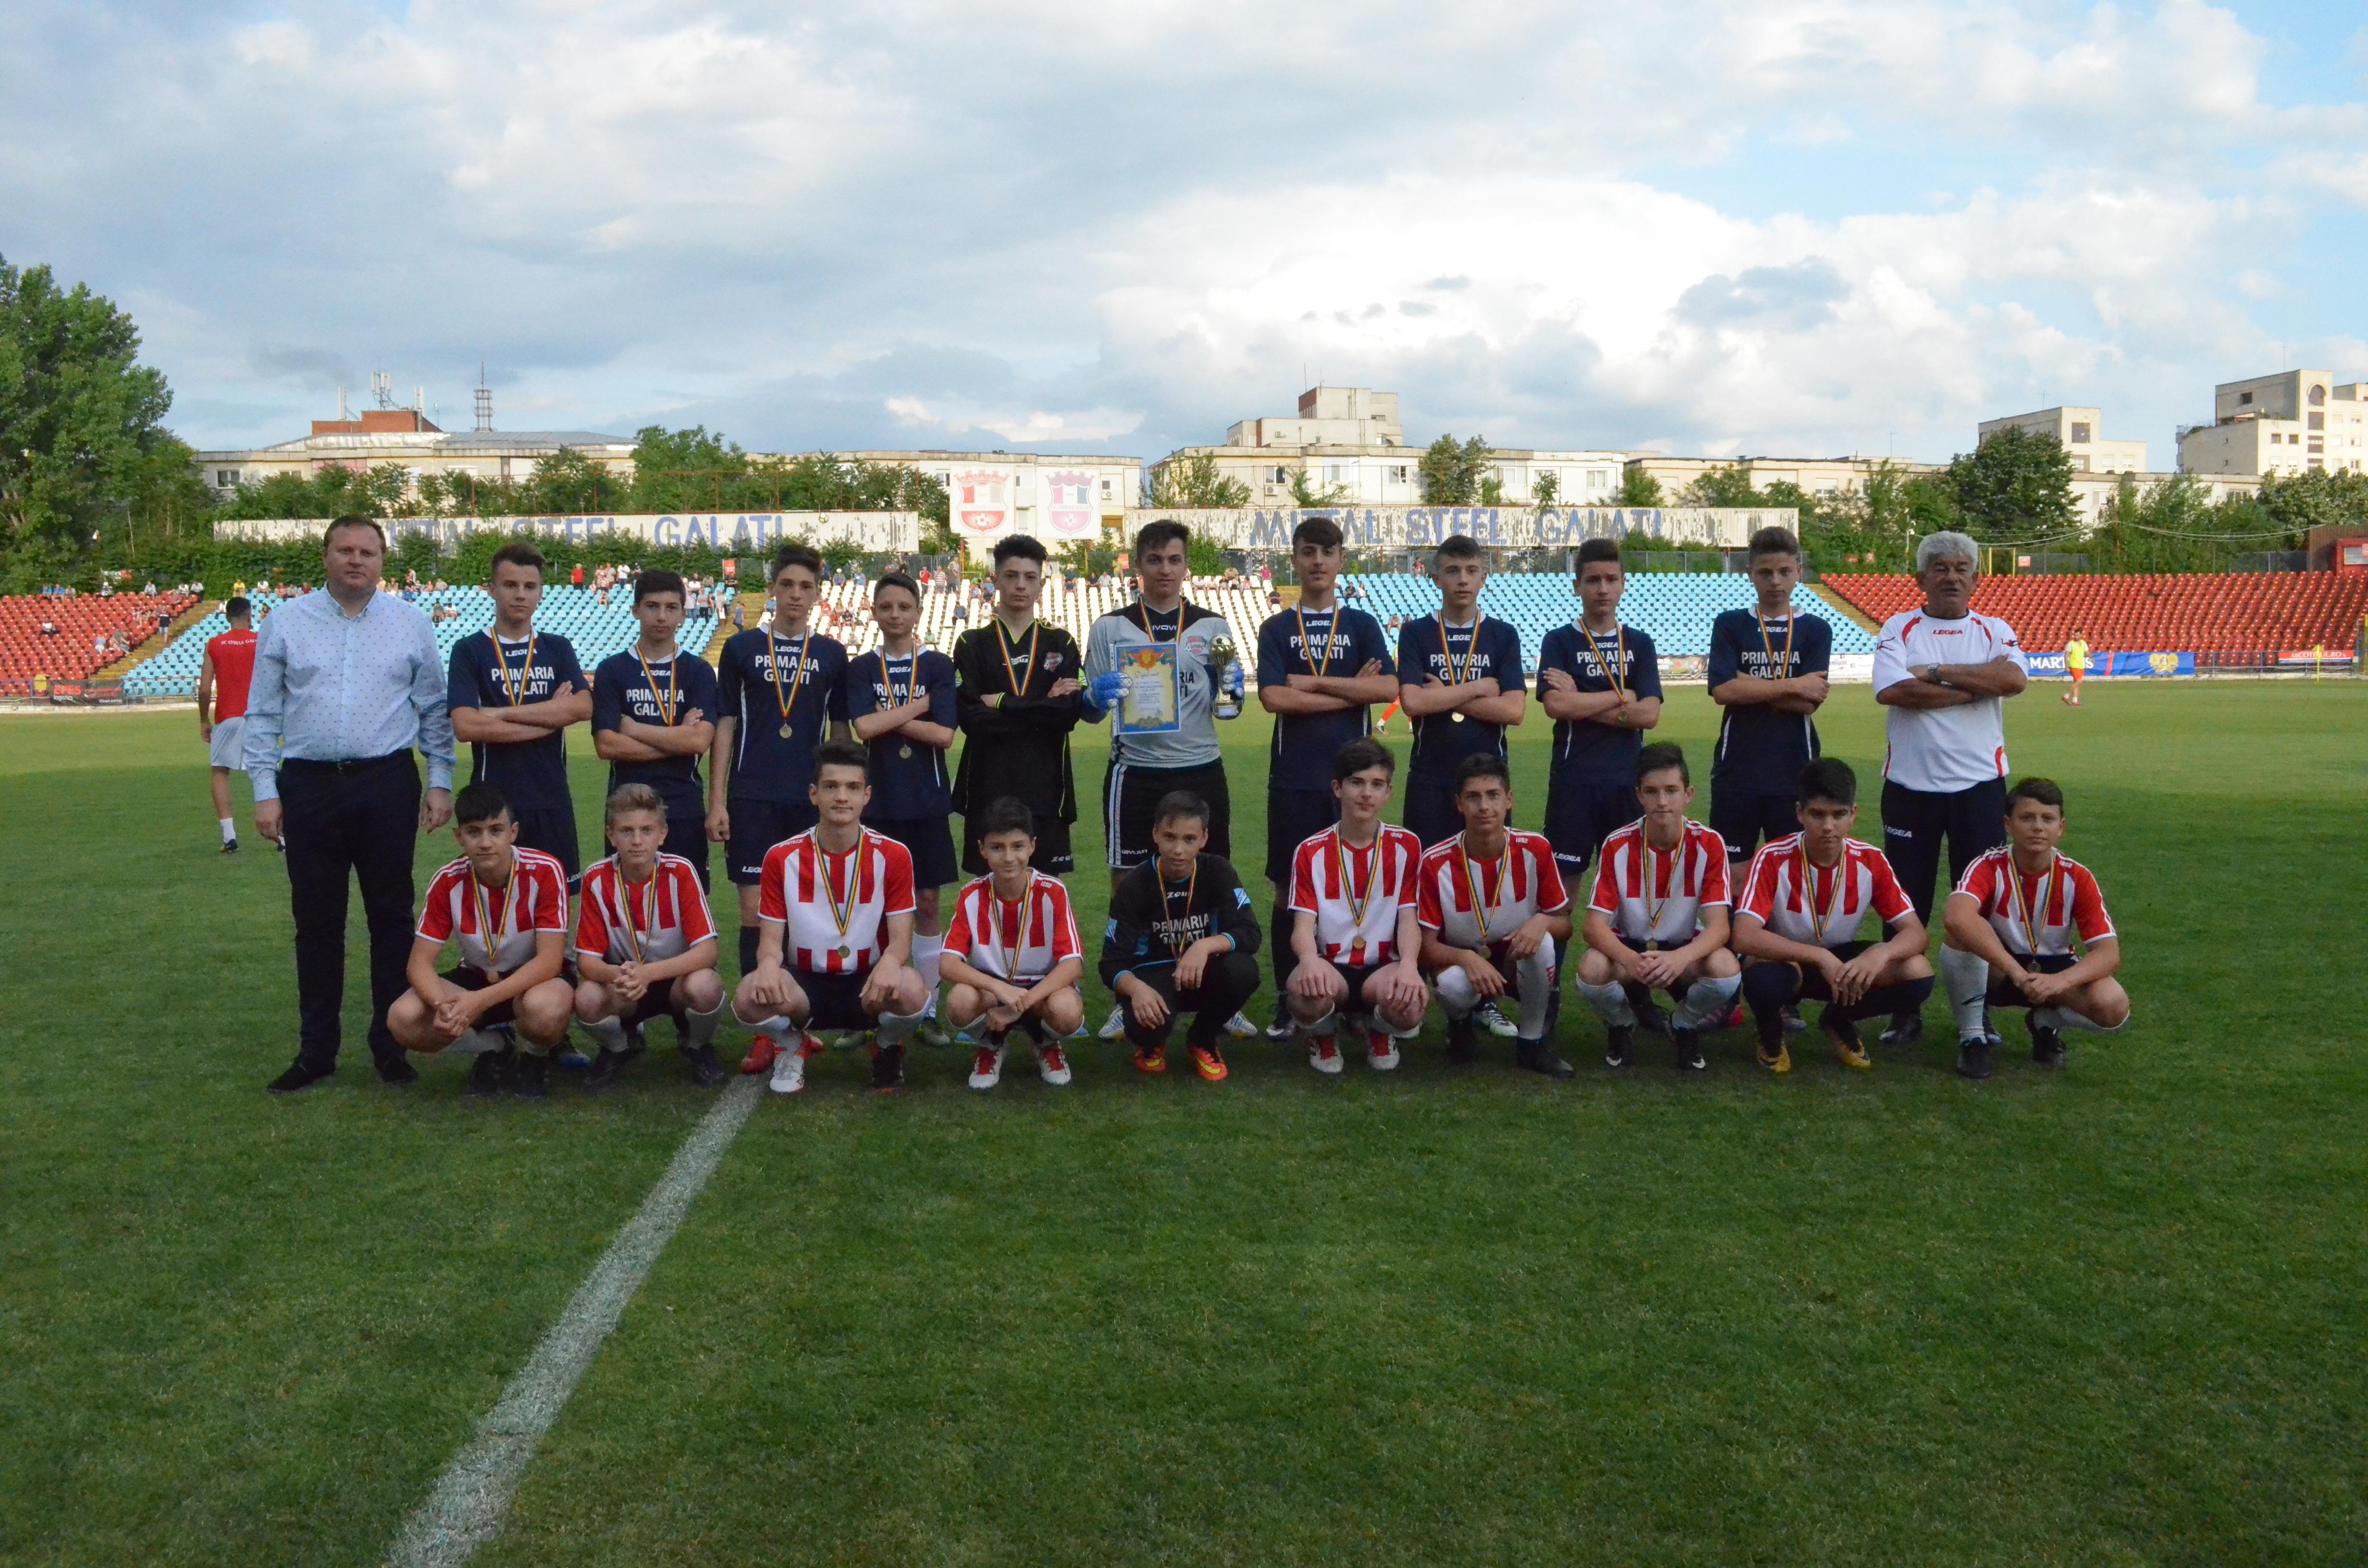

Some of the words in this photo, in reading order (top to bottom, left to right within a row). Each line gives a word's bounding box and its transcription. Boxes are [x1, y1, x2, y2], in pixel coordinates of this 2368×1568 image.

[1406, 508, 1508, 544] STEEL
[755, 655, 819, 672] PRMARIA
[1430, 654, 1490, 667] PRMARIA
[1439, 668, 1481, 680] GLTI
[1587, 663, 1628, 676] GAAI
[1750, 665, 1792, 678] GALAI
[54, 685, 82, 695] EFES
[873, 683, 925, 698] RIMAIA
[634, 703, 676, 716] GALTI
[1554, 852, 1581, 863] LEGEA
[1152, 913, 1209, 932] PRIMARIA
